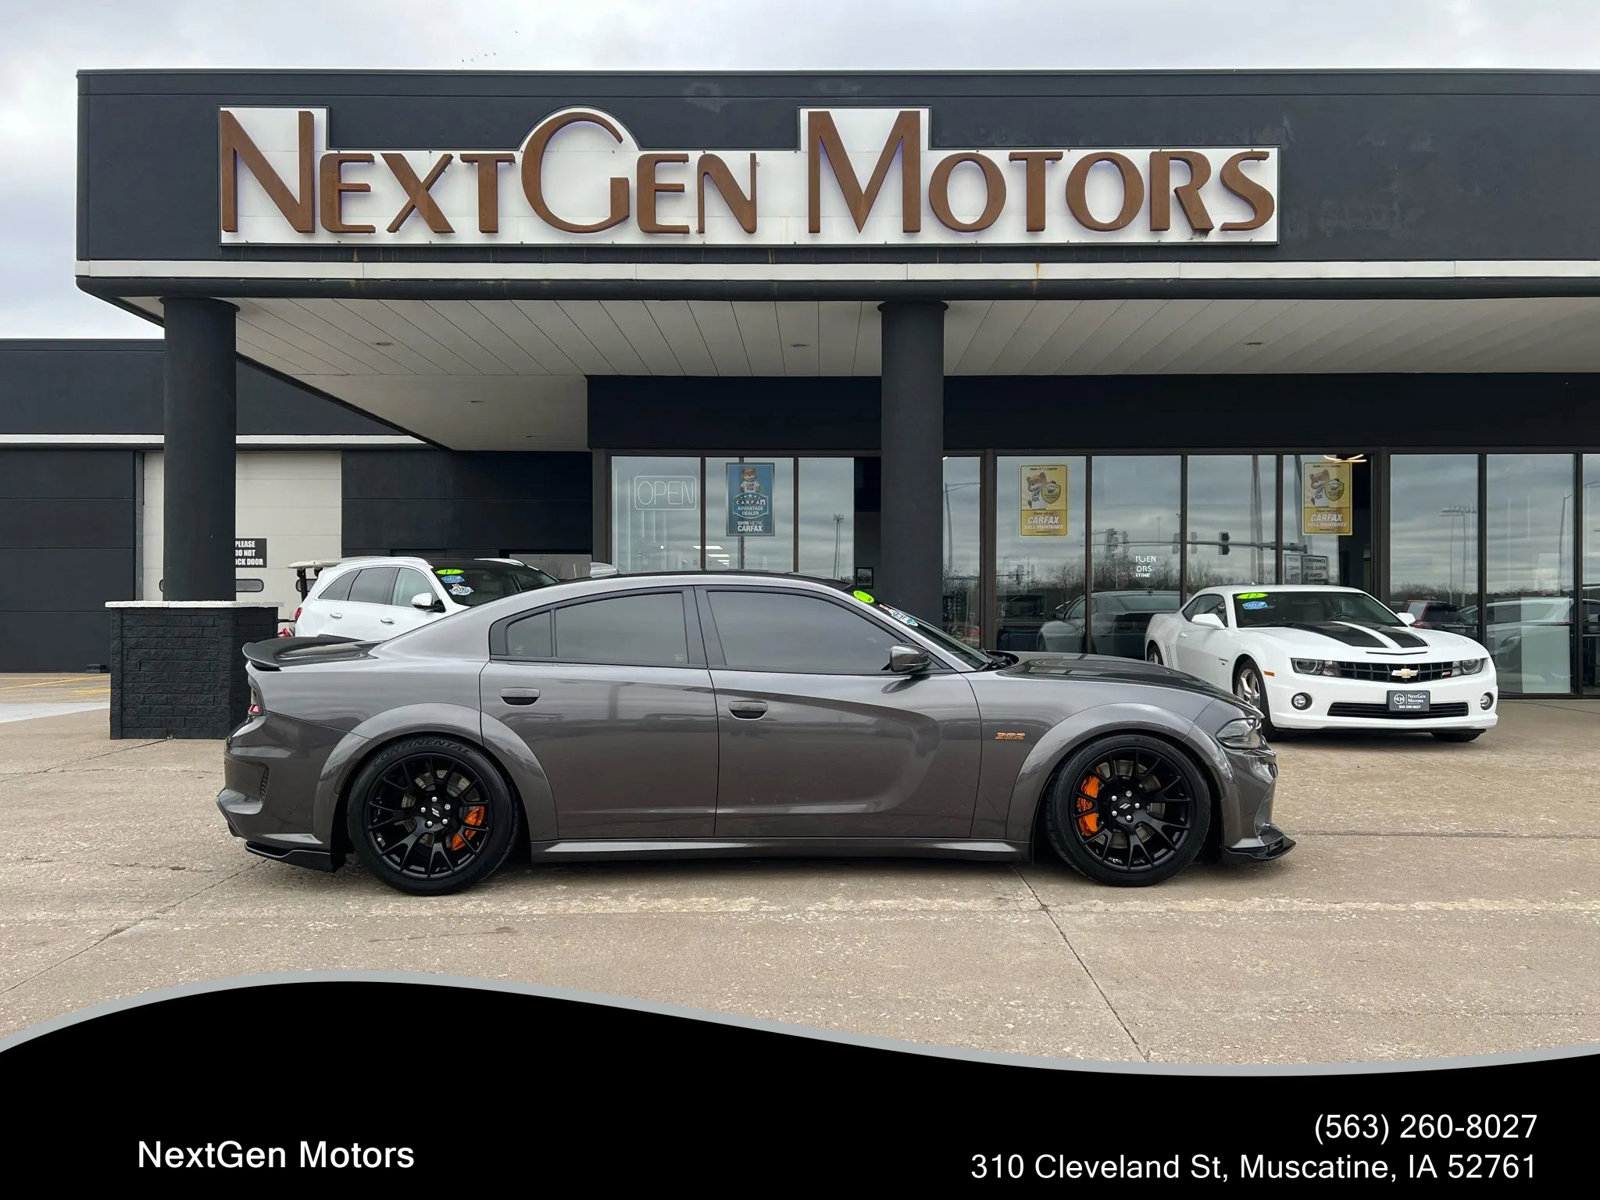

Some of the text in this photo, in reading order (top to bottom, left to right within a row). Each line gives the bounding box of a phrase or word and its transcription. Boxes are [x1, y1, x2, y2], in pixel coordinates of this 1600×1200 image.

[637, 480, 694, 506] OPEN
[1027, 516, 1060, 524] CARFAX
[1310, 513, 1344, 522] CARFAX
[243, 549, 256, 557] NOT
